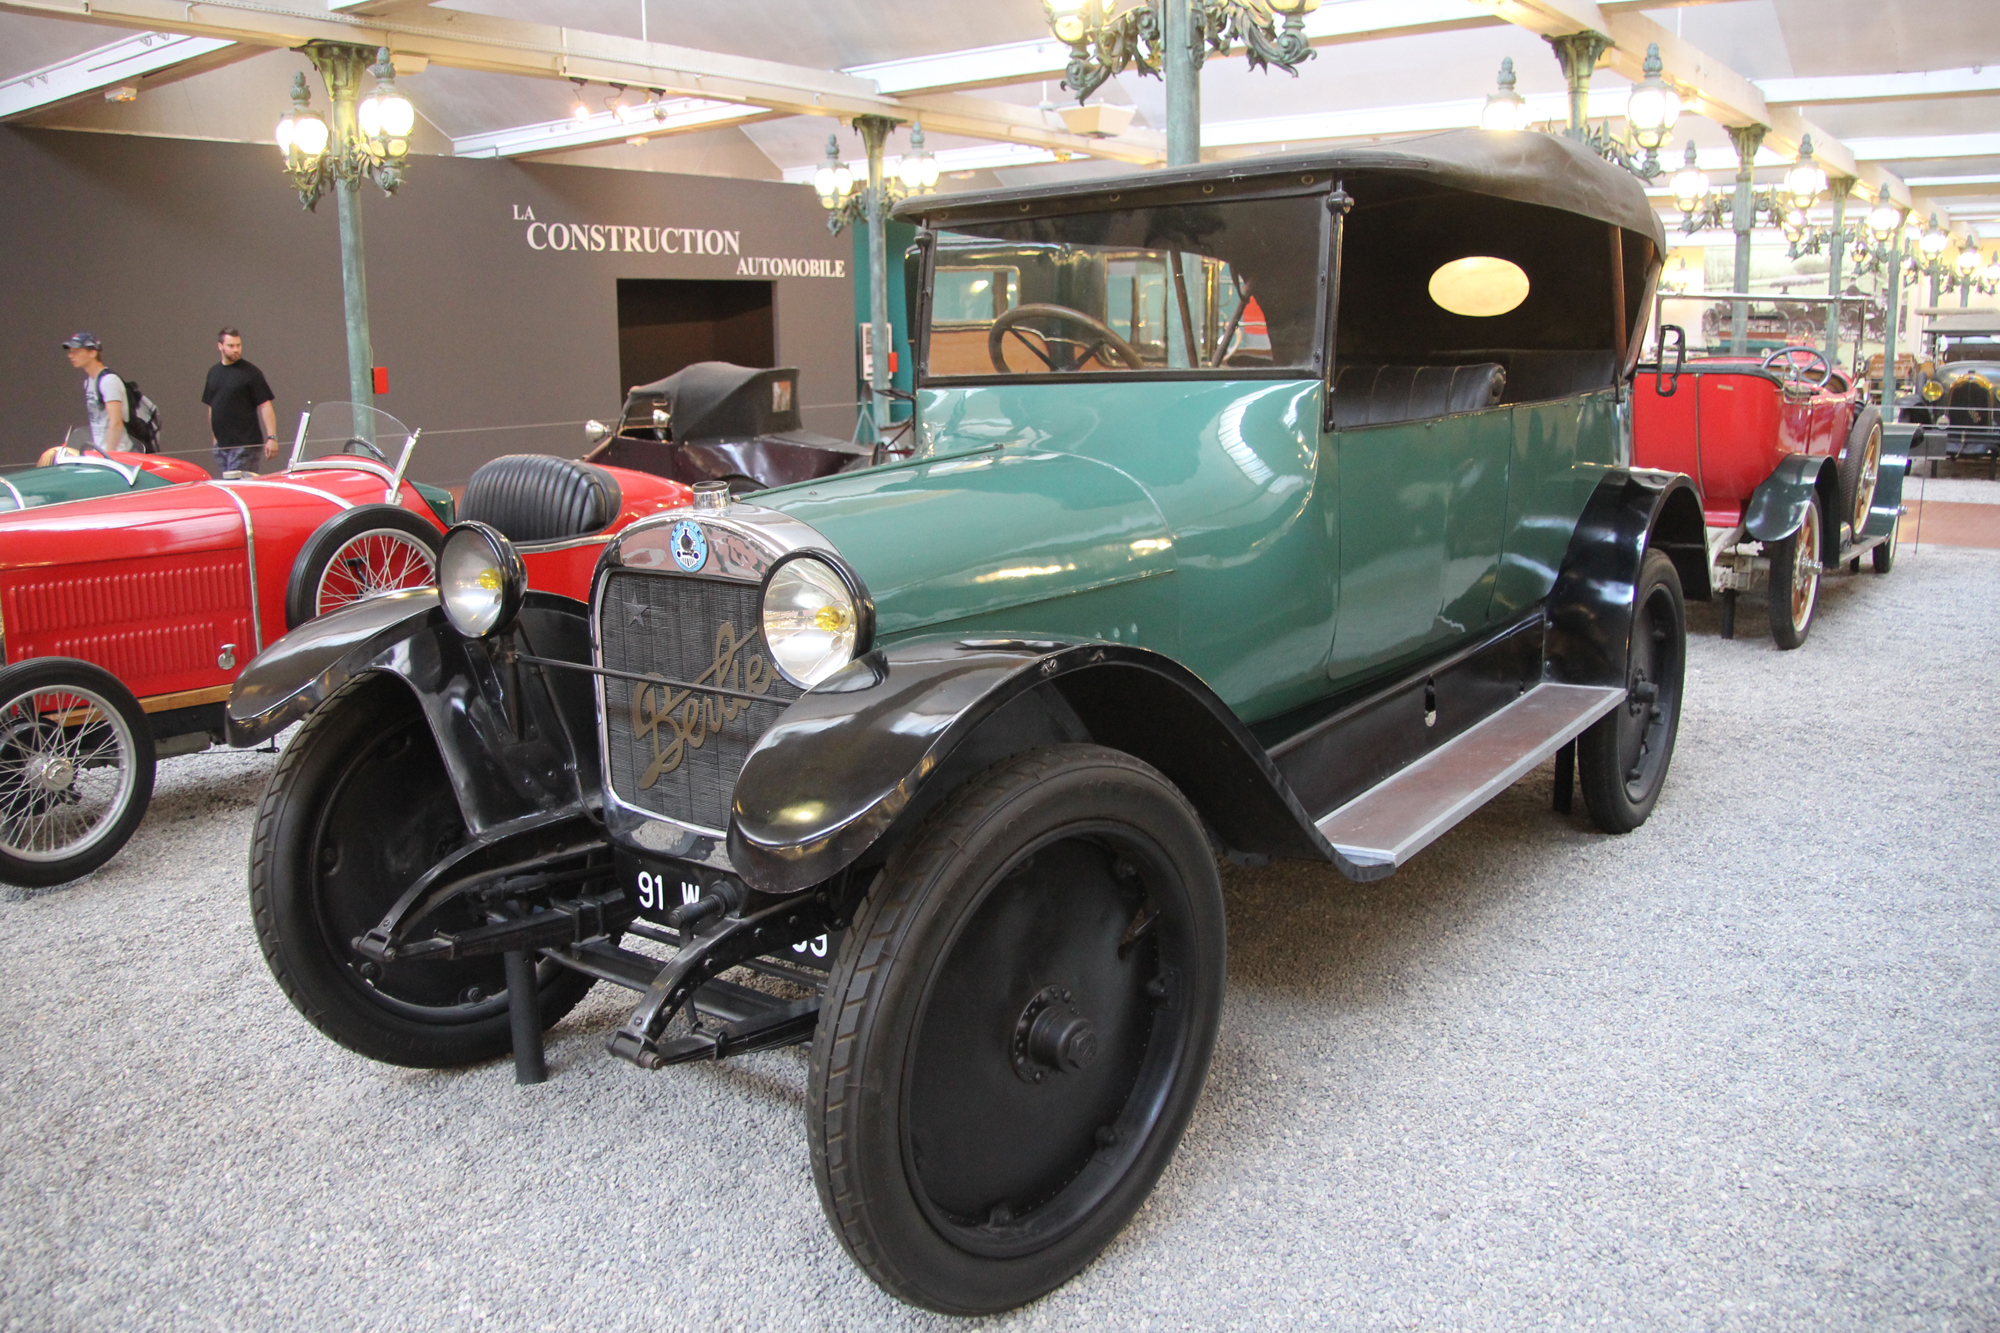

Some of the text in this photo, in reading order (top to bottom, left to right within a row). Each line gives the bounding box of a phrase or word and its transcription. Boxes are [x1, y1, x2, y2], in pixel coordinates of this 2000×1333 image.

[512, 204, 536, 221] LA
[526, 222, 740, 256] CONSTRUCTION
[736, 257, 845, 278] AUTOMOBILE
[671, 521, 706, 545] BERLIET
[631, 621, 784, 790] Berlie
[637, 870, 664, 911] 91
[681, 881, 700, 906] W
